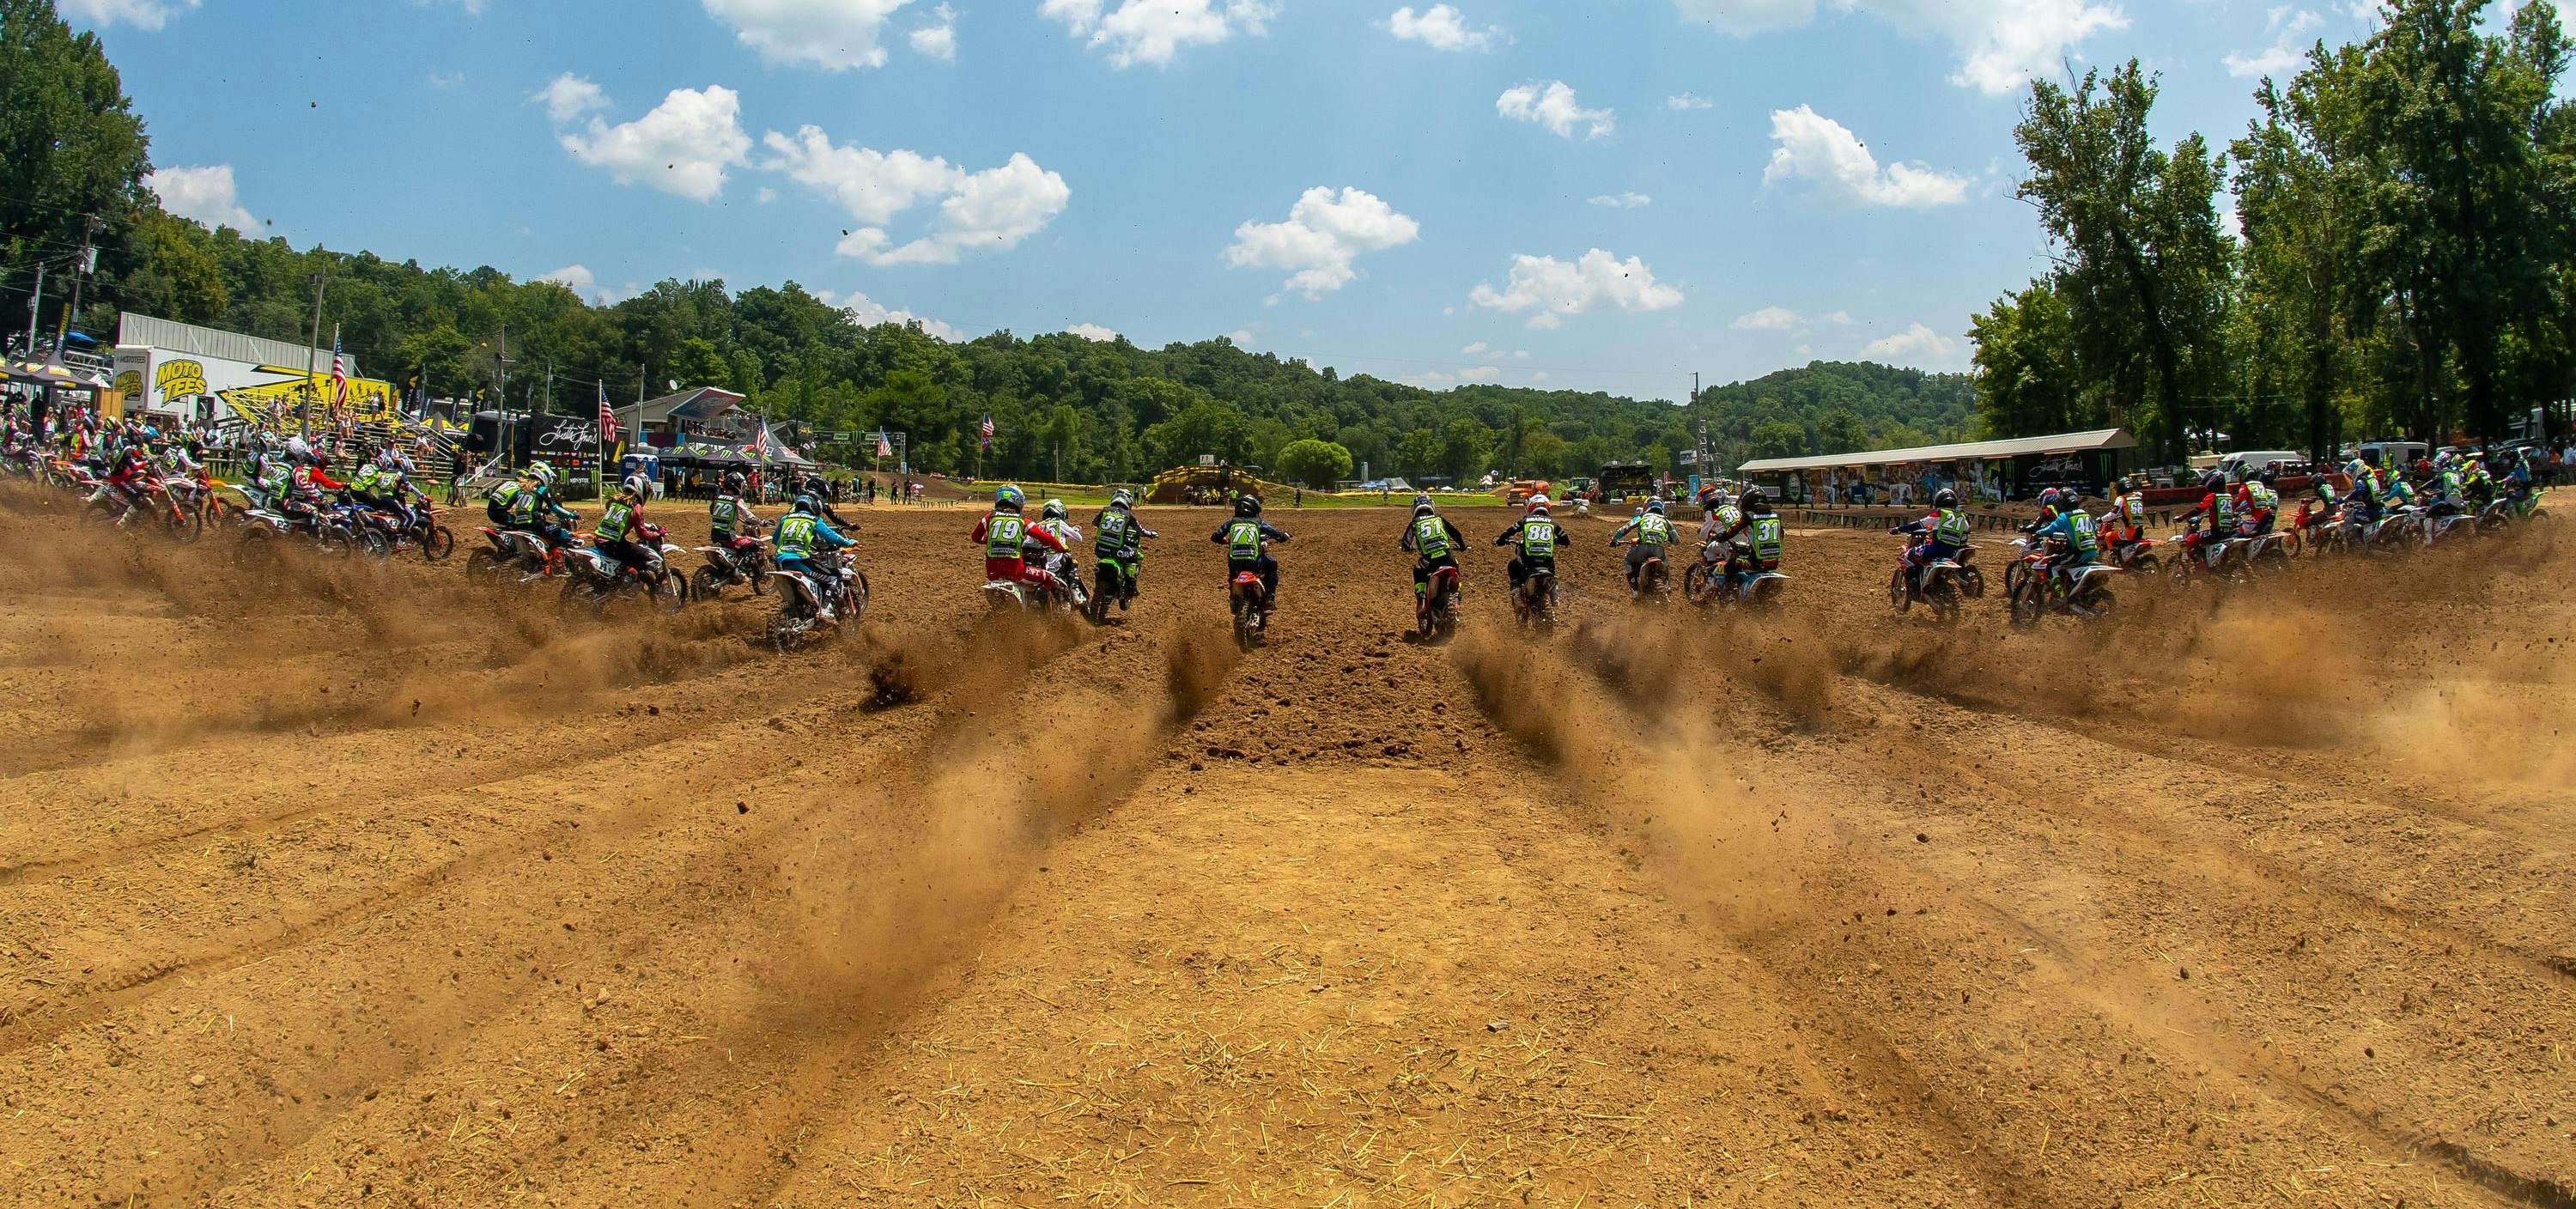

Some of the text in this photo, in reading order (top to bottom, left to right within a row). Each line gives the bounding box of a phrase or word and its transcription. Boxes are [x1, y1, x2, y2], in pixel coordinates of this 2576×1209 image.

[155, 360, 203, 392] MOTO
[161, 377, 207, 407] TEES
[516, 495, 532, 508] 70
[714, 503, 732, 517] 72
[2130, 502, 2143, 514] 66
[2220, 500, 2233, 513] 25
[605, 506, 627, 523] 14
[1722, 507, 1741, 523] 36
[1941, 513, 1964, 531] 21
[783, 520, 811, 538] 41
[991, 520, 1019, 539] 19
[1101, 515, 1125, 532] 33
[1420, 519, 1441, 538] 51
[1644, 518, 1663, 530] 32
[1757, 521, 1778, 541] 31
[1232, 526, 1256, 543] 71
[1528, 525, 1552, 541] 88
